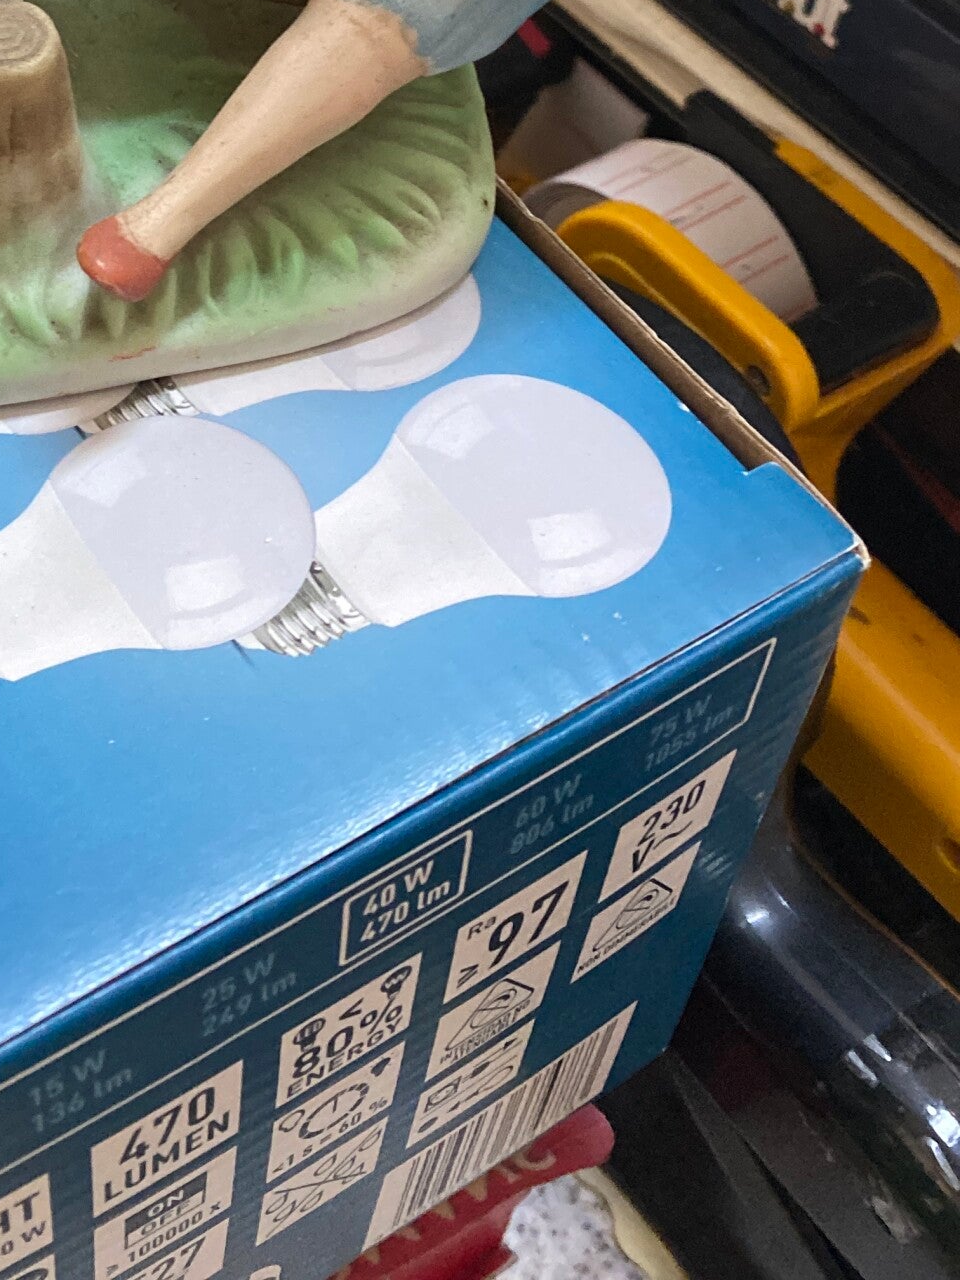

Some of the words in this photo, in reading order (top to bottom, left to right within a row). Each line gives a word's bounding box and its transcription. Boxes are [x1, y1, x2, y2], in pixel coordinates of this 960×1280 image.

[686, 694, 711, 720] W
[515, 795, 547, 829] 60
[553, 773, 583, 805] W
[638, 779, 707, 847] 230
[510, 818, 556, 855] 806
[361, 901, 409, 942] 470
[417, 881, 450, 910] lm
[363, 883, 396, 916] 40
[404, 860, 434, 893] W
[203, 977, 237, 1013] 25
[244, 952, 275, 986] W
[203, 993, 252, 1037] 249
[292, 997, 403, 1079] 80%
[29, 1073, 65, 1107] 15
[72, 1049, 106, 1083] W
[287, 1016, 403, 1098] ENERGY
[32, 1092, 86, 1133] 136
[118, 1086, 216, 1166] 470
[103, 1109, 231, 1203] LUMEN
[21, 1220, 47, 1243] W
[140, 1199, 190, 1237] OFF
[147, 1188, 185, 1219] ON
